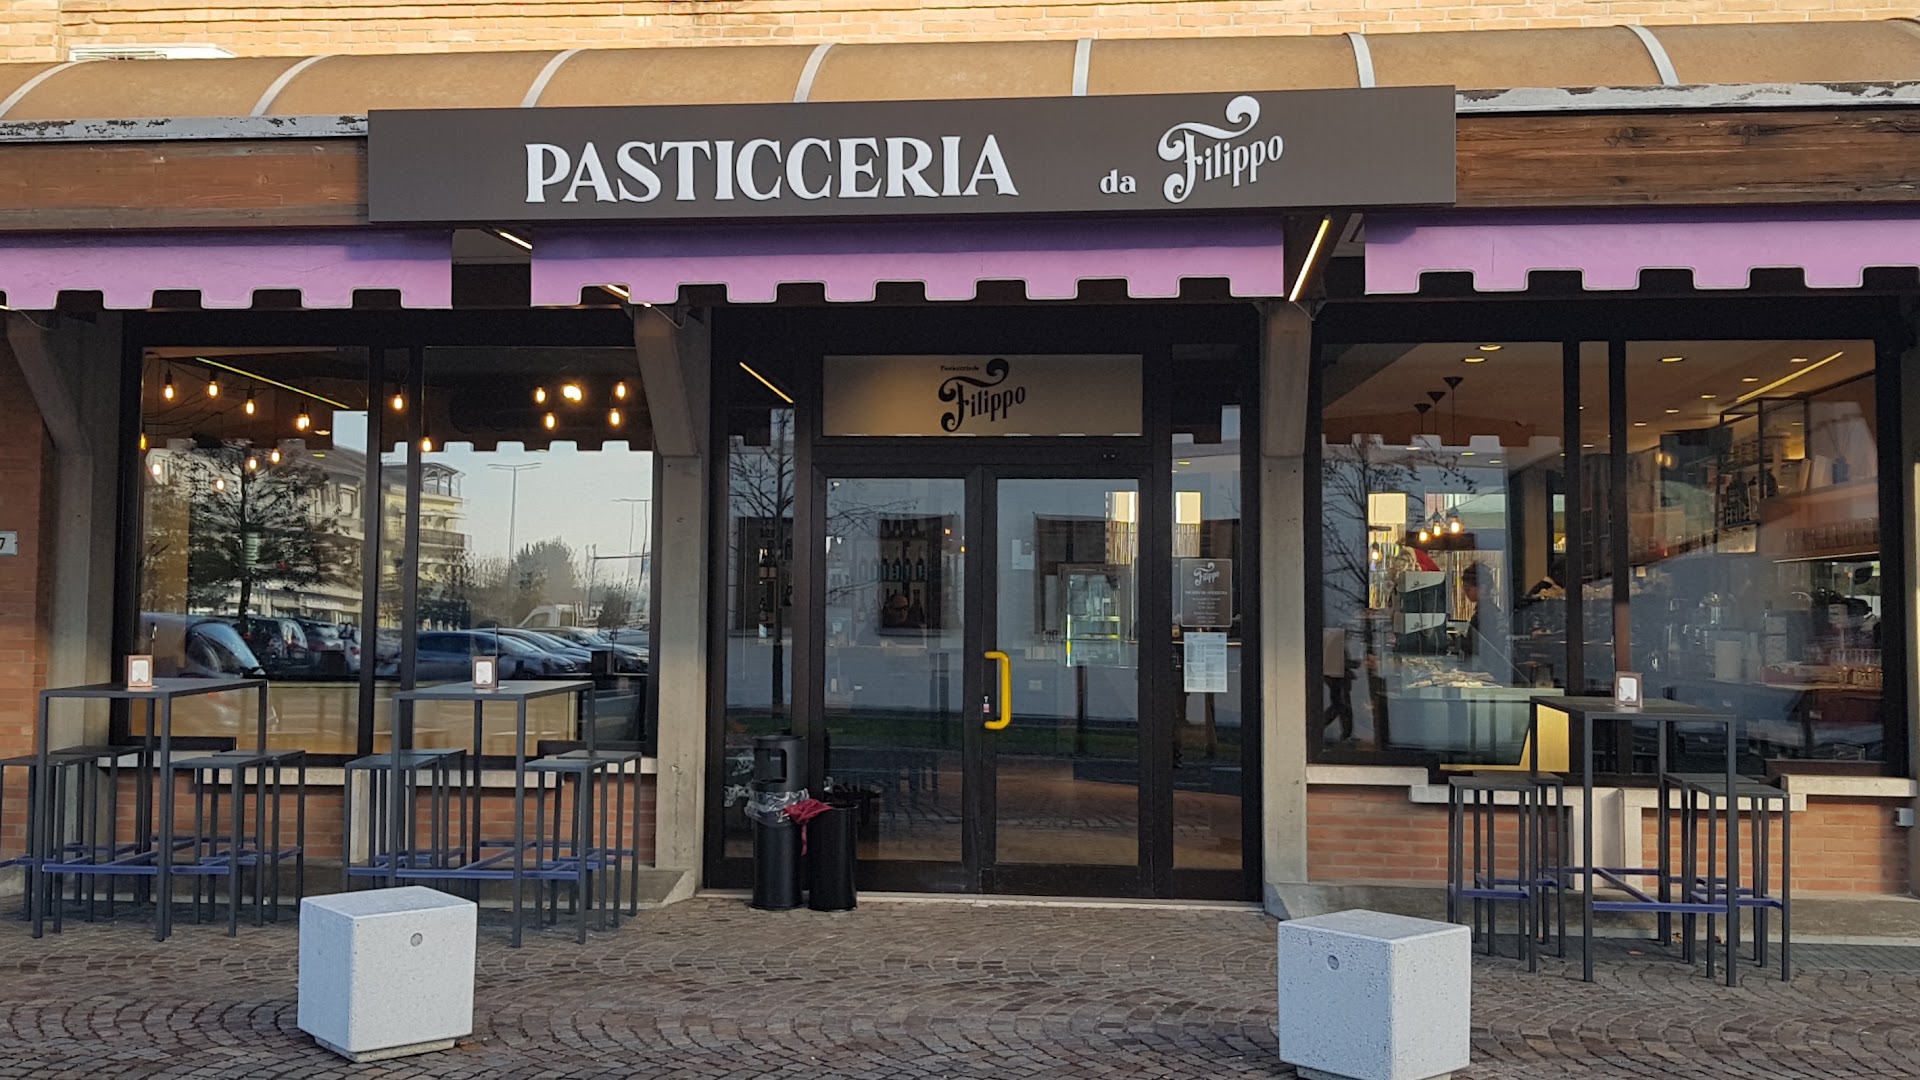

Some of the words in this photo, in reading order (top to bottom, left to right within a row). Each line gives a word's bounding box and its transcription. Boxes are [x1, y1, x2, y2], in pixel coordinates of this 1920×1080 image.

[525, 134, 1019, 203] PASTICCERIA
[1100, 169, 1137, 194] da
[1157, 95, 1284, 203] Filippo
[938, 358, 1026, 432] Filippo
